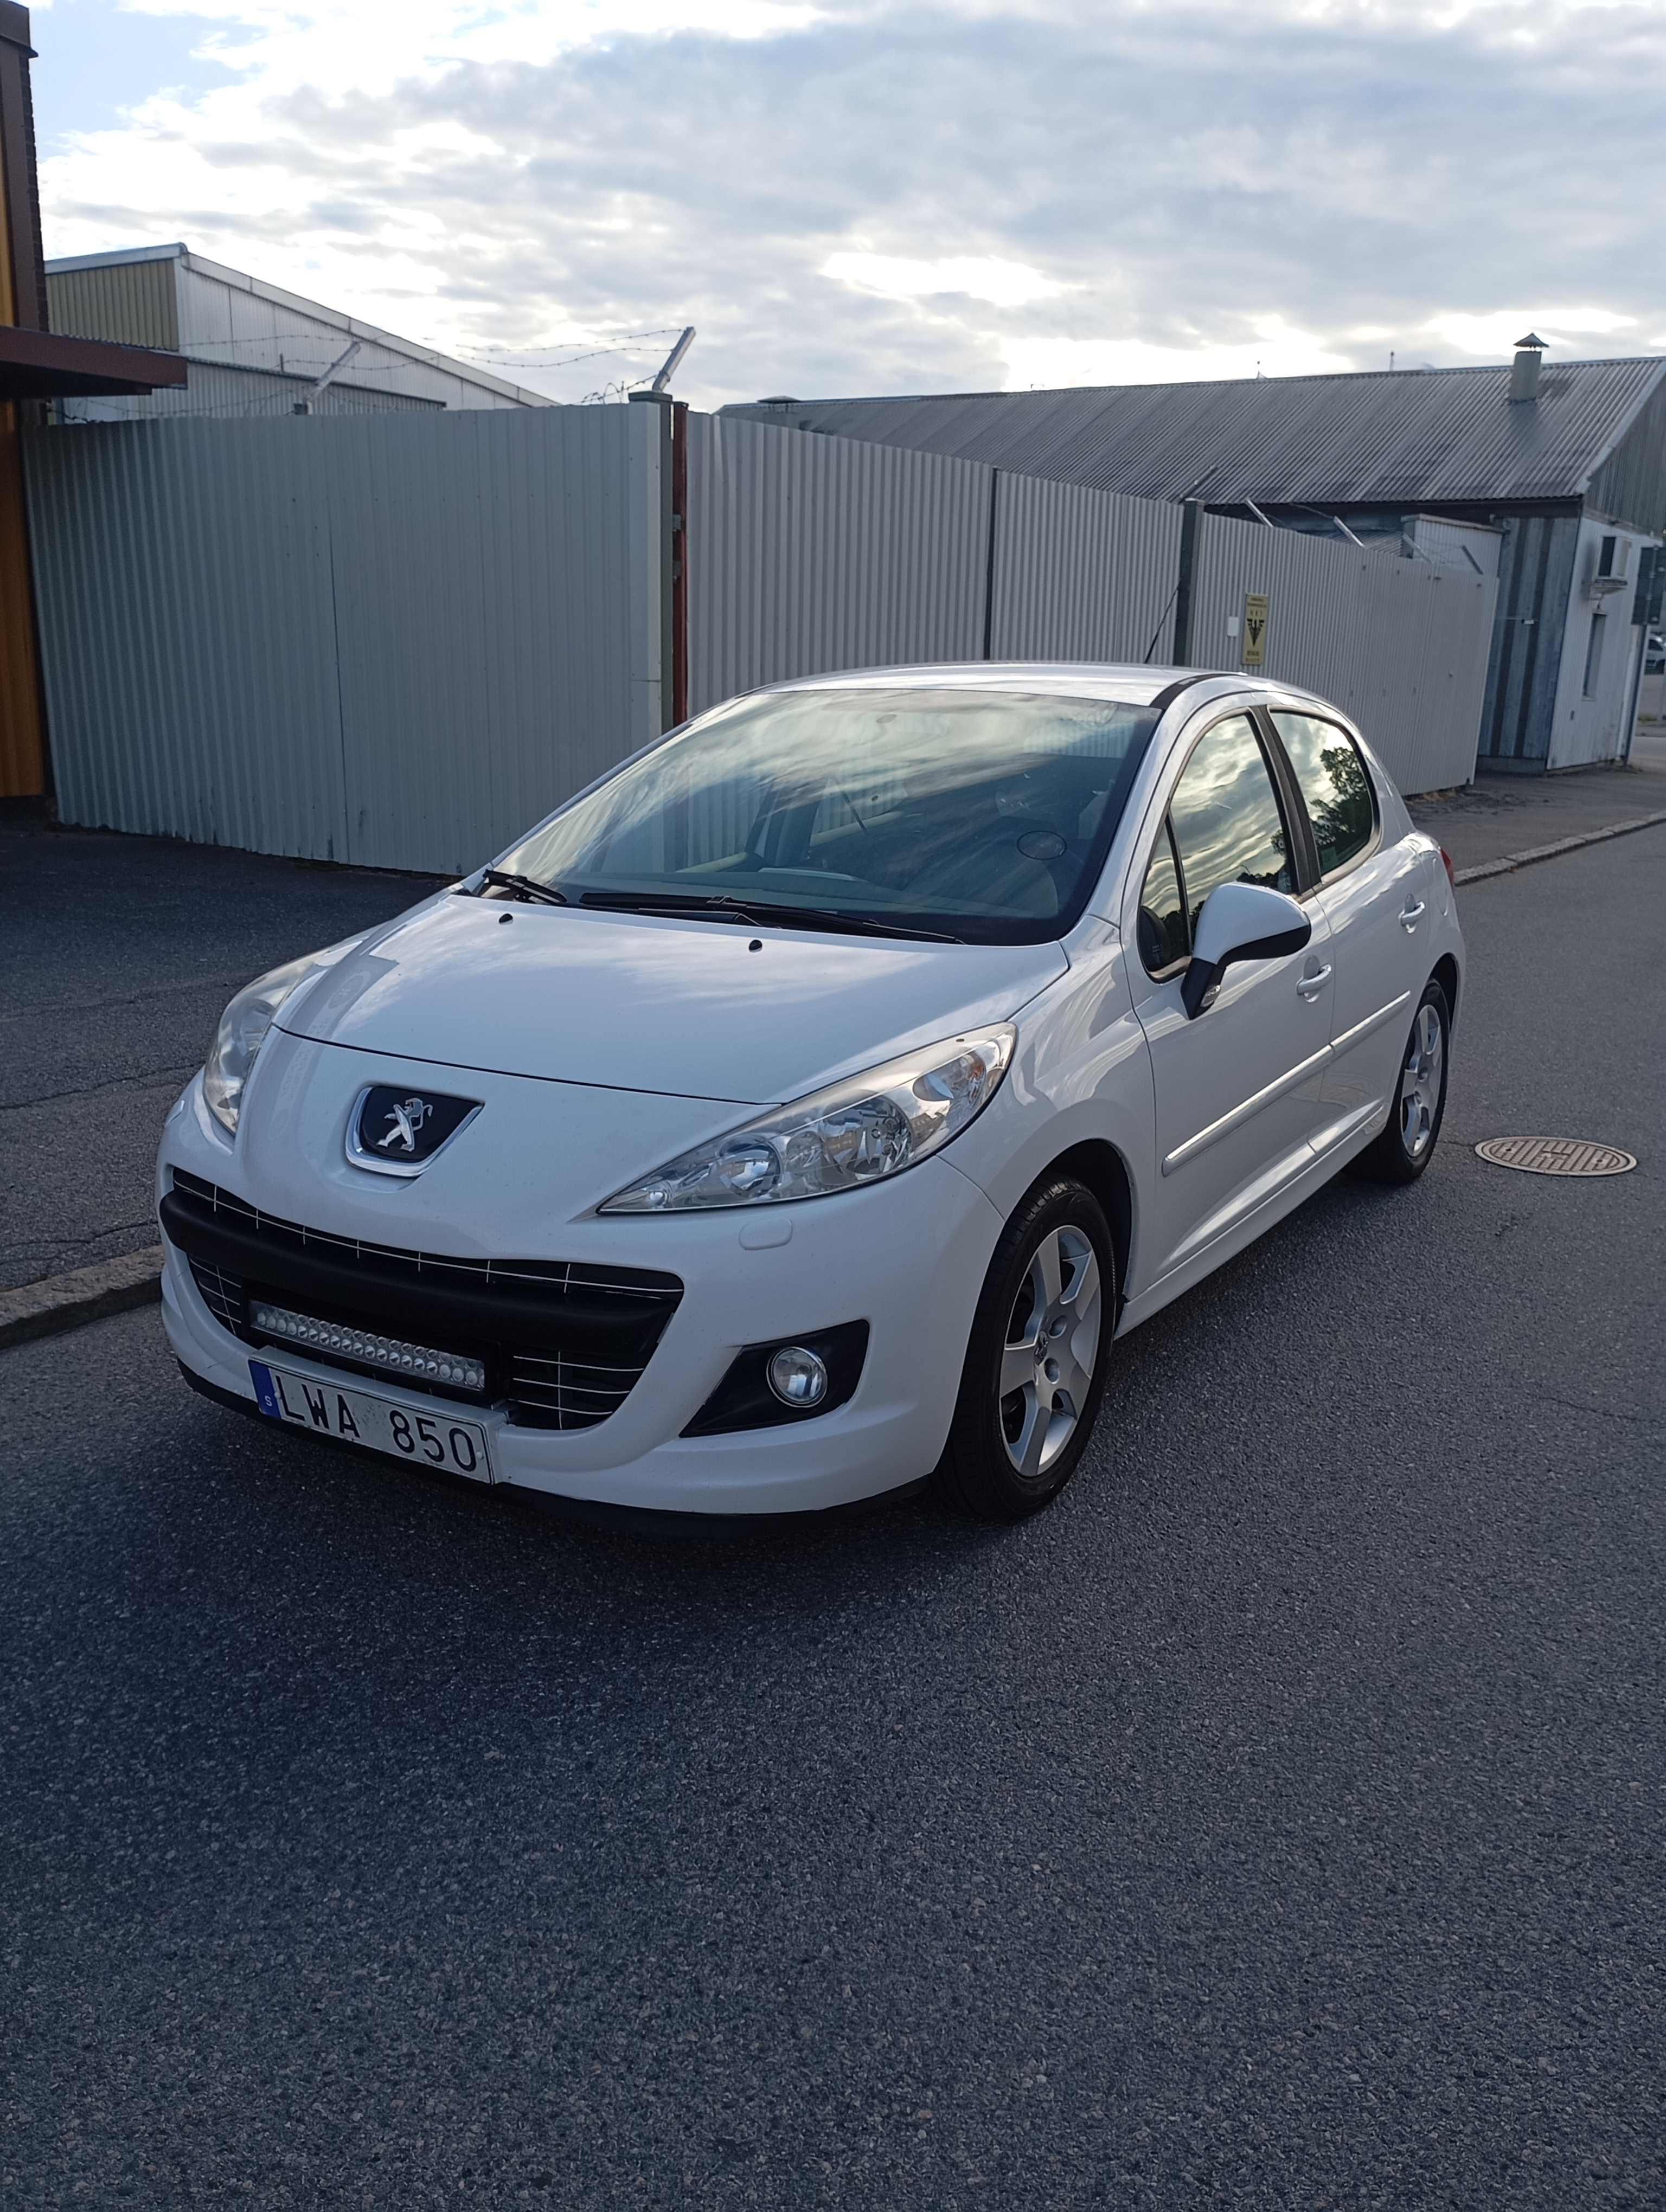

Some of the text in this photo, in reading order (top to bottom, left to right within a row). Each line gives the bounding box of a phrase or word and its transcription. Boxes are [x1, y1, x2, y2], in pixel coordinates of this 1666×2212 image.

[264, 1395, 272, 1407] S
[275, 1374, 477, 1472] LWA 850
